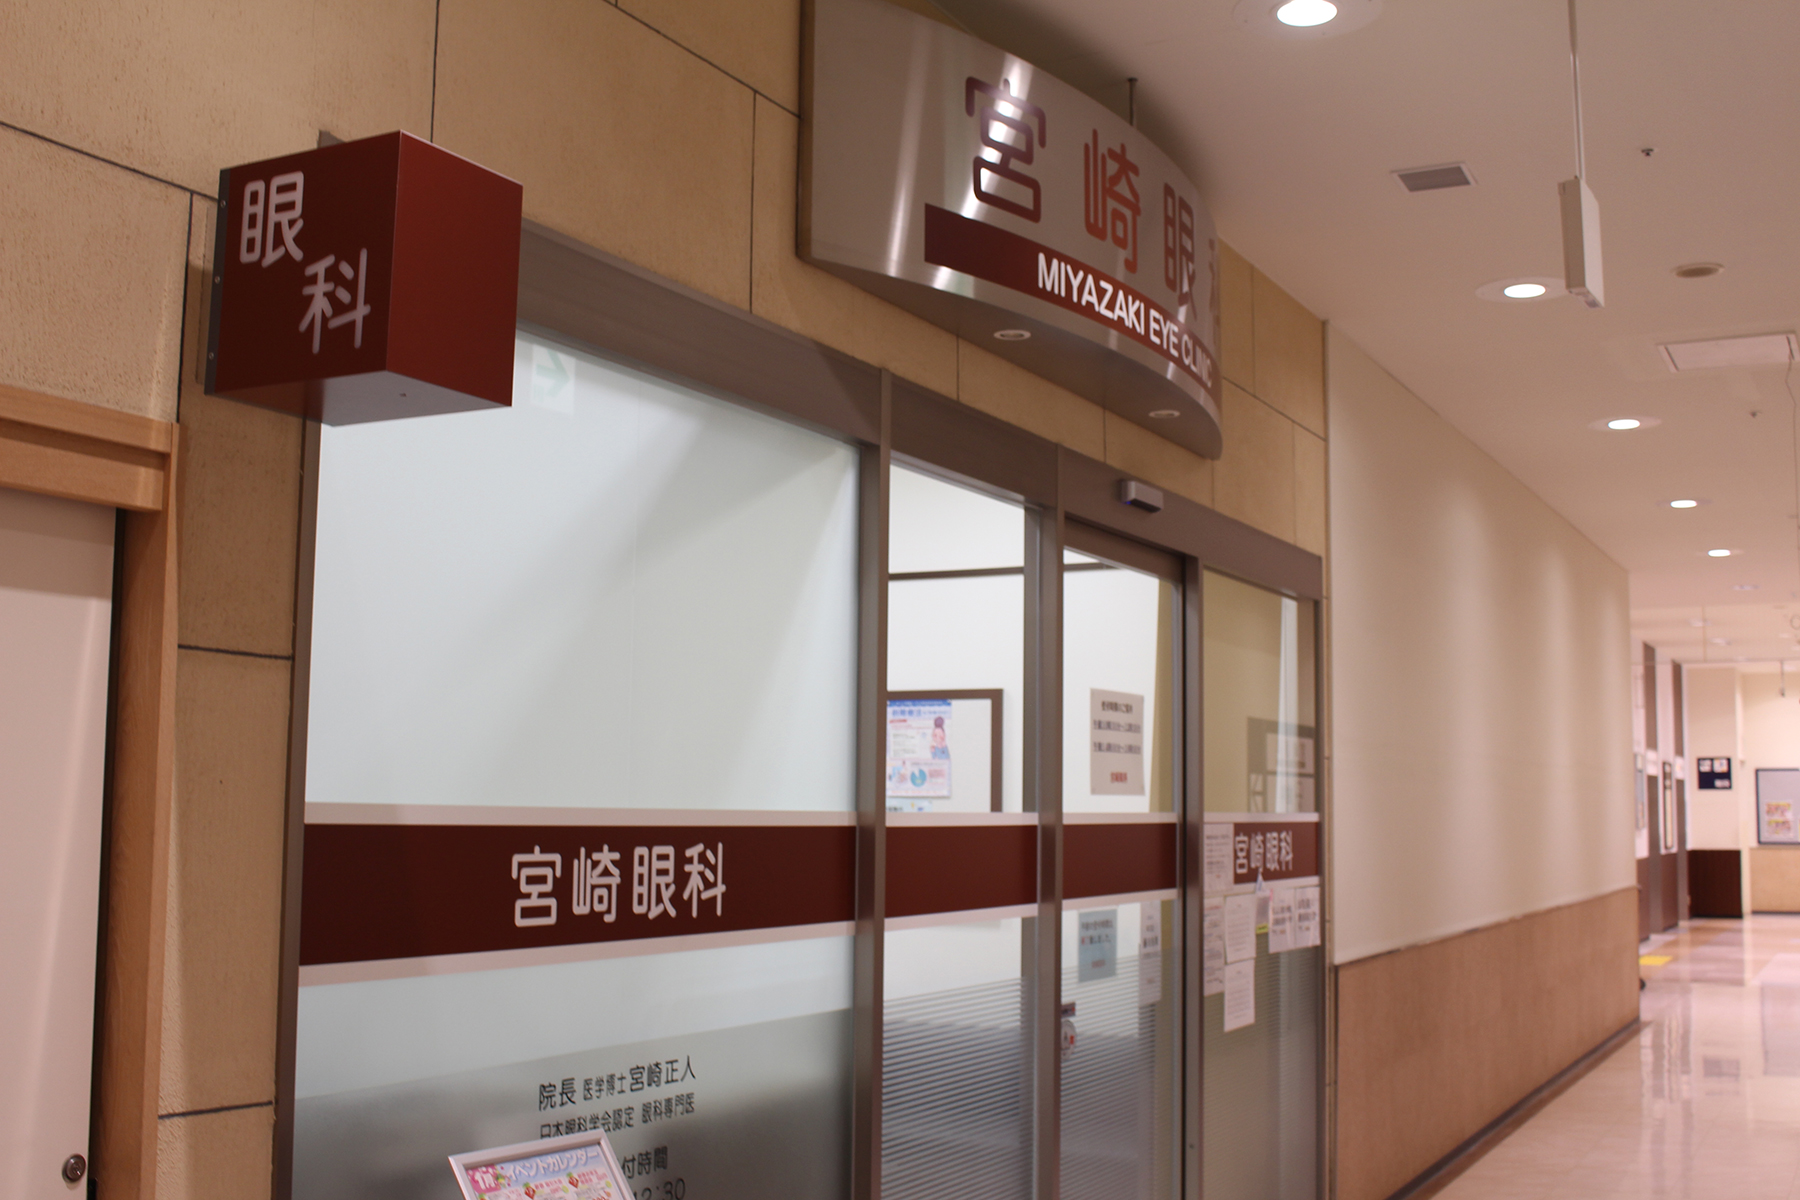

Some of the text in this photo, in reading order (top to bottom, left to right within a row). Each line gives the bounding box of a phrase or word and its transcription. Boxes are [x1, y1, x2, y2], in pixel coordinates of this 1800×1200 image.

[240, 171, 371, 354] 眼科
[965, 76, 1220, 345] 宮崎眼
[1037, 252, 1213, 389] MIYAZAKI EYE CLINIC
[511, 842, 726, 928] 宮崎眼科
[539, 1077, 577, 1112] 院長
[507, 1148, 600, 1181] イベントカレンダー
